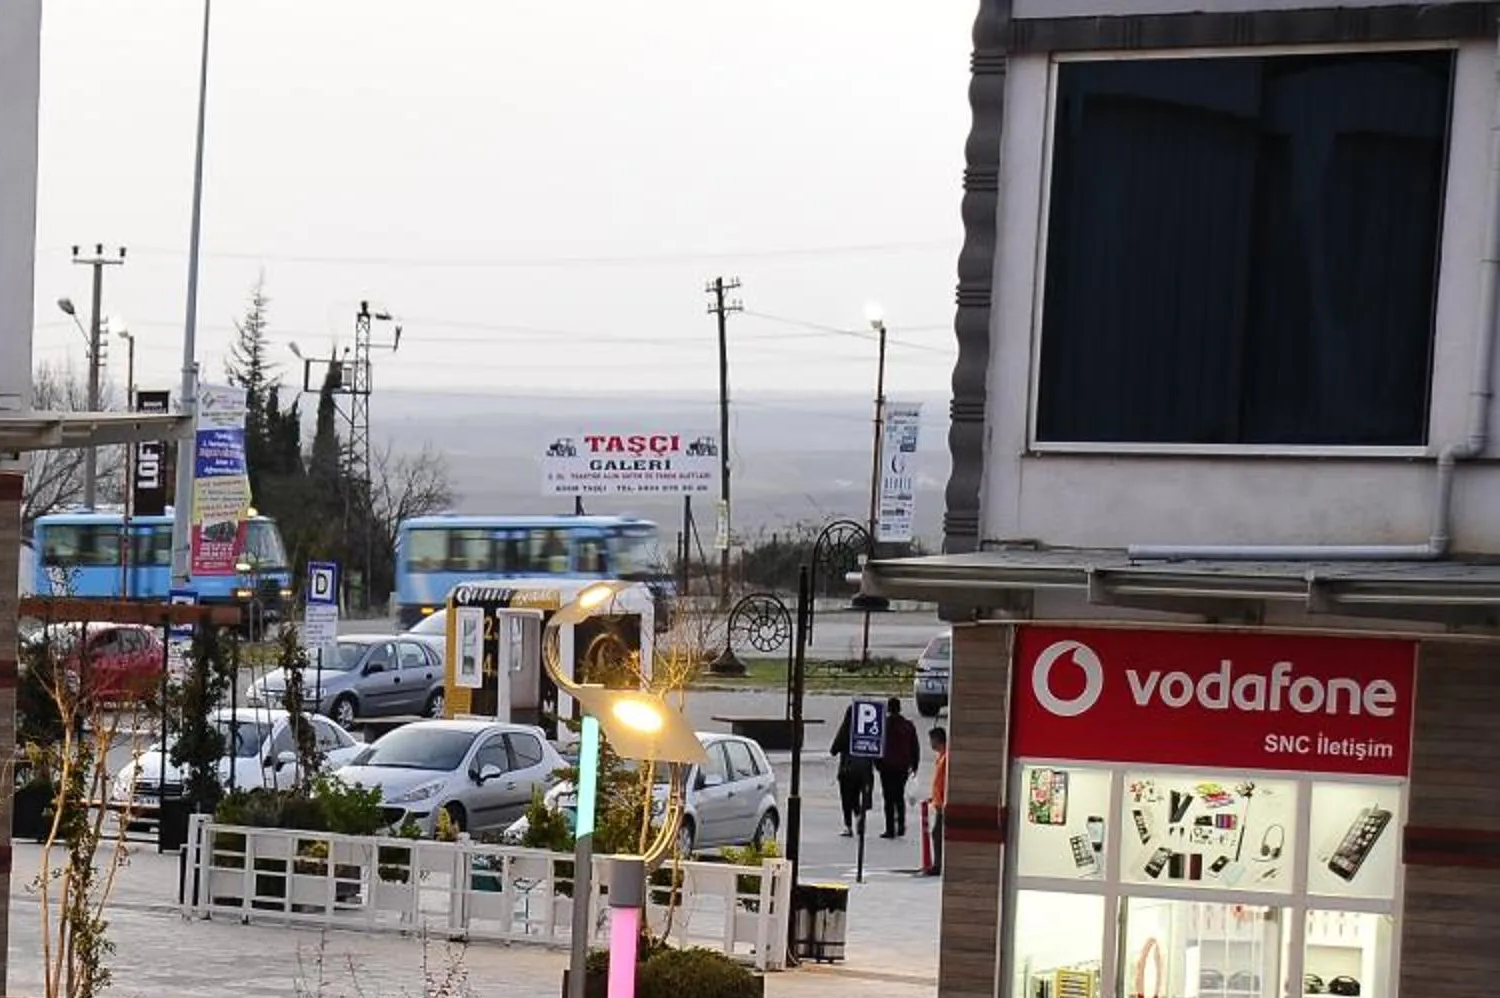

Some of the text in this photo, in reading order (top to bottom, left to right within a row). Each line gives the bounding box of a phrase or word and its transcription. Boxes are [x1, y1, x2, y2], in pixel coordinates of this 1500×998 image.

[583, 435, 681, 457] TAŞÇI
[1125, 659, 1397, 717] vodafone
[857, 703, 877, 735] P
[1264, 732, 1394, 761] SNC İletişim
